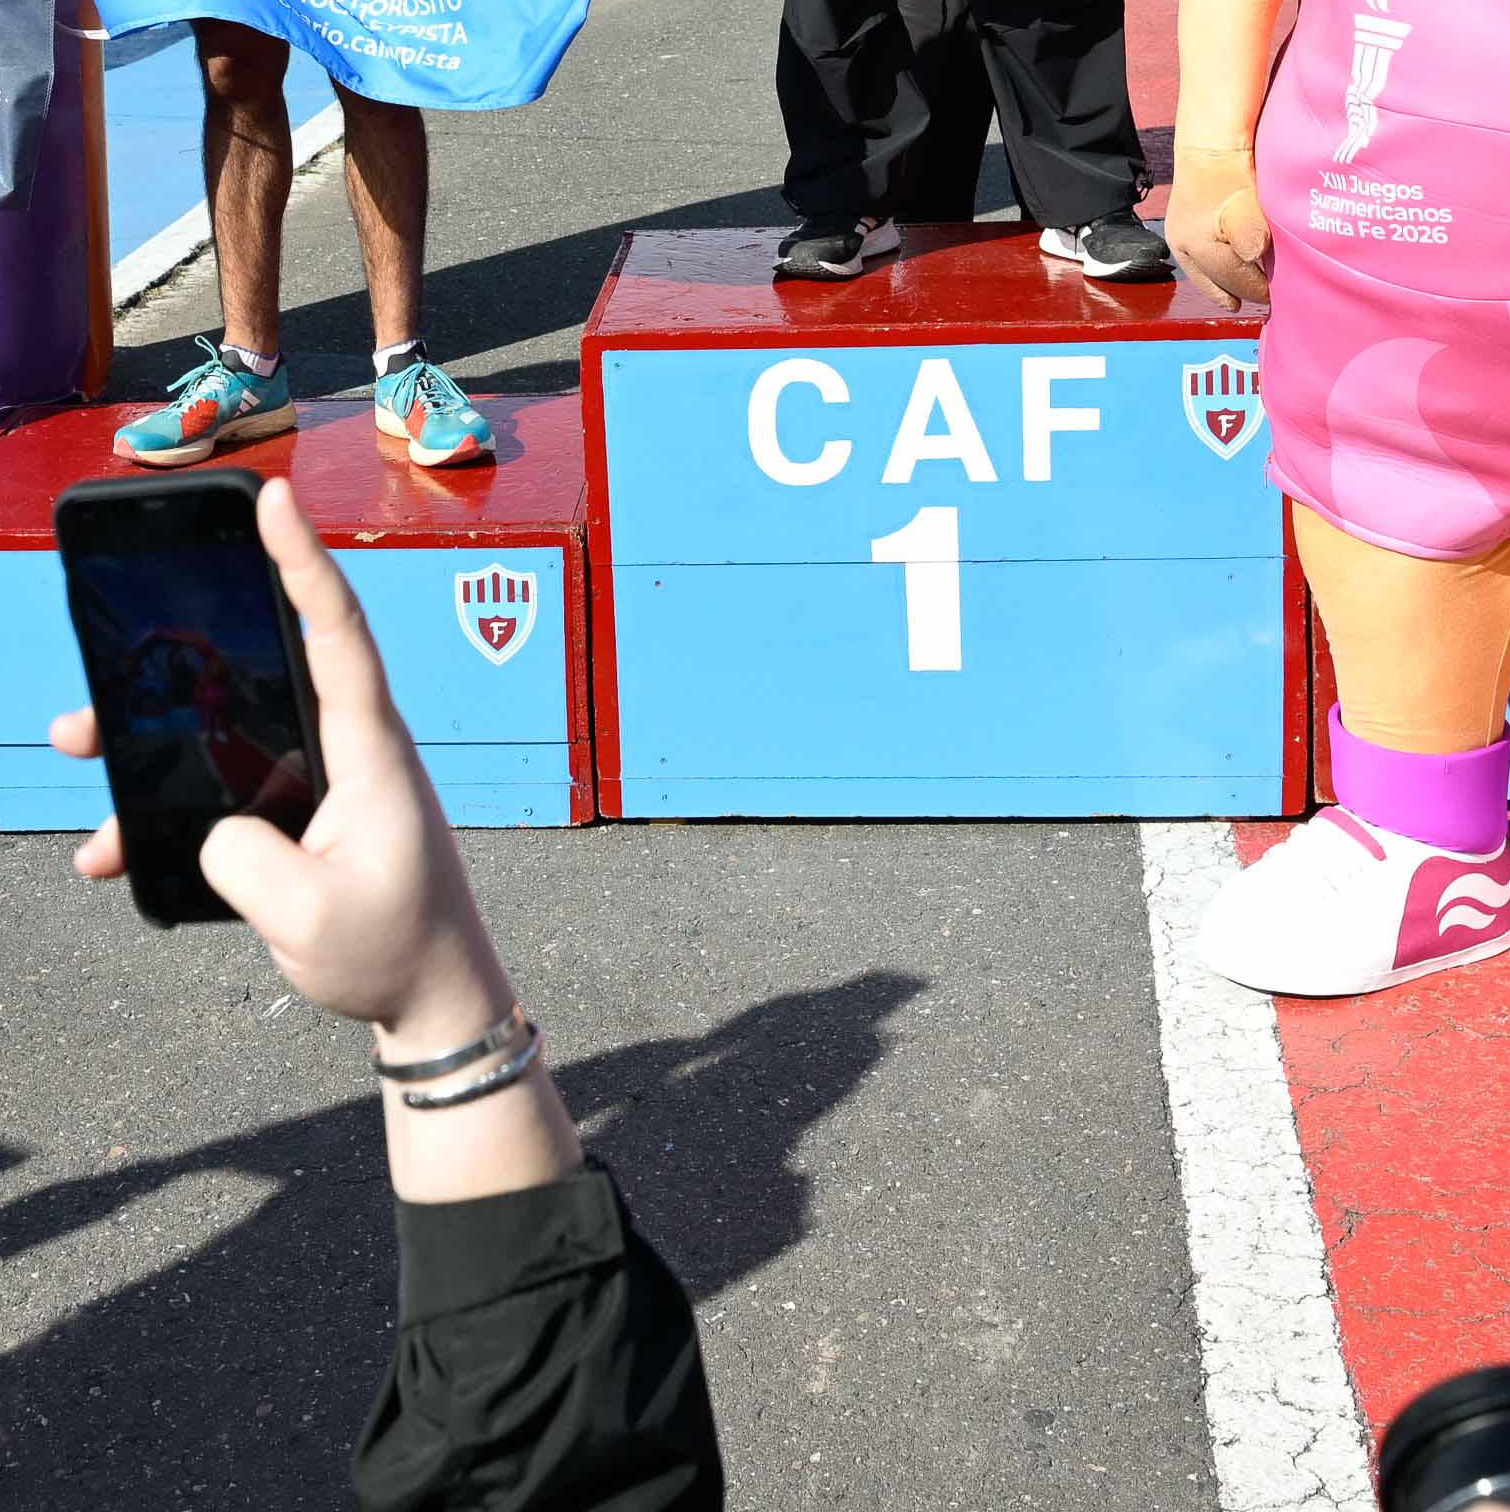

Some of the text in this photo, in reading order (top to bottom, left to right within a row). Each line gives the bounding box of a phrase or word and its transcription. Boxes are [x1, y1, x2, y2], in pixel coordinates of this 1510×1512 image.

[1318, 170, 1424, 203] XIII Juegos
[1309, 187, 1453, 224] Suramericanos
[1307, 208, 1449, 245] Santa Fe 2026
[747, 355, 1107, 487] CAF
[871, 505, 963, 672] 1
